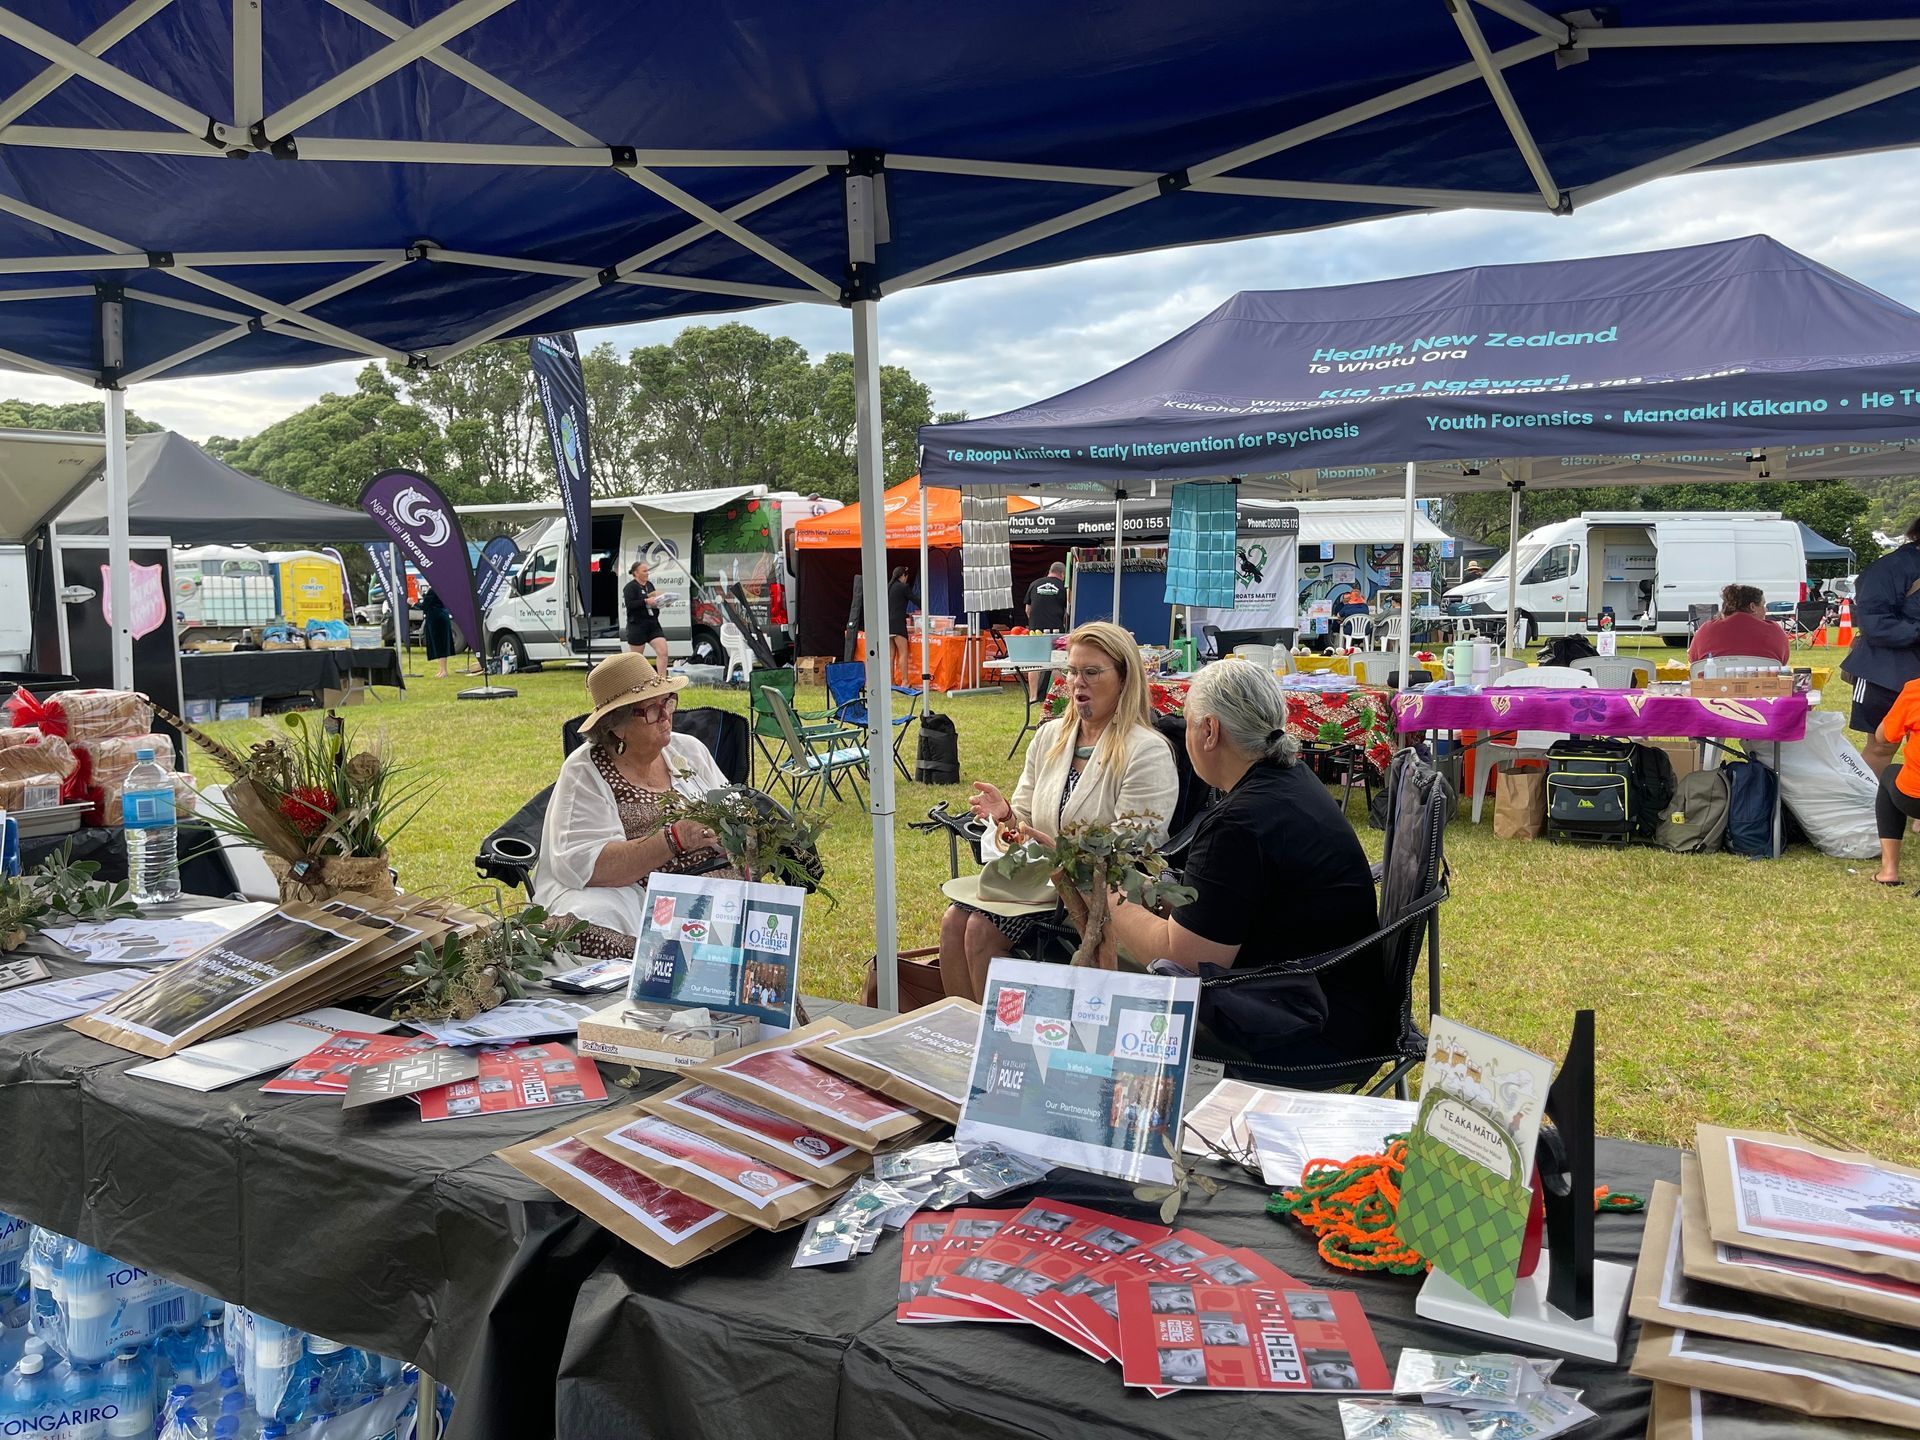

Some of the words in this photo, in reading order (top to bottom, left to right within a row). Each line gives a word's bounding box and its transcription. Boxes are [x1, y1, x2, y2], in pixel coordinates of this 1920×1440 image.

[1312, 342, 1403, 362] Health
[1411, 334, 1477, 353] New
[1484, 326, 1619, 349] Zealand
[1308, 364, 1331, 374] Te
[1338, 356, 1415, 373] Whatu
[1421, 350, 1467, 362] Ora
[1318, 388, 1371, 399] Kia
[1378, 382, 1415, 395] Tū
[1421, 374, 1570, 392] Ngāwari
[1426, 413, 1486, 431] Youth
[1491, 410, 1593, 428] Forensics
[1623, 402, 1727, 424] Manaaki
[1732, 396, 1827, 417] Kākano
[1862, 391, 1894, 409] He
[947, 449, 963, 462] Te
[966, 448, 1011, 465] Roopu
[1014, 447, 1071, 461] Kimiora
[1089, 444, 1128, 462] Early
[1131, 435, 1235, 458] Intervention
[1238, 431, 1264, 447] for
[1266, 421, 1359, 447] Psychosis
[1024, 526, 1049, 534] Zealand
[1036, 516, 1056, 526] Ora
[1077, 521, 1115, 533] Phone:
[1123, 518, 1144, 530] 800
[1145, 517, 1164, 529] 155
[400, 532, 434, 568] Ihorangi
[657, 576, 684, 585] Ihorangi
[479, 590, 495, 612] Youth
[1840, 752, 1865, 778] HOSPITAL
[749, 928, 788, 951] Oranga
[761, 927, 772, 937] Te
[772, 929, 788, 941] Ara
[653, 960, 674, 977] POLICE
[690, 984, 702, 992] Our
[703, 985, 736, 997] Partnerships
[1078, 1011, 1109, 1021] ODYSSEY
[904, 1031, 922, 1040] He
[913, 1025, 931, 1034] He
[930, 1031, 973, 1048] Oranga
[1141, 1029, 1155, 1043] Te
[582, 1040, 600, 1051] Pacific
[600, 1043, 619, 1054] Classic
[1121, 1033, 1177, 1060] Oranga
[674, 1057, 689, 1065] Facial
[997, 1068, 1024, 1089] POLICE
[1045, 1100, 1057, 1109] Our
[1060, 1102, 1101, 1118] Partnerships
[1443, 1109, 1454, 1122] TE
[1454, 1116, 1472, 1132] AKA
[1473, 1124, 1503, 1148] MĀTUA
[1168, 1320, 1184, 1343] HELP
